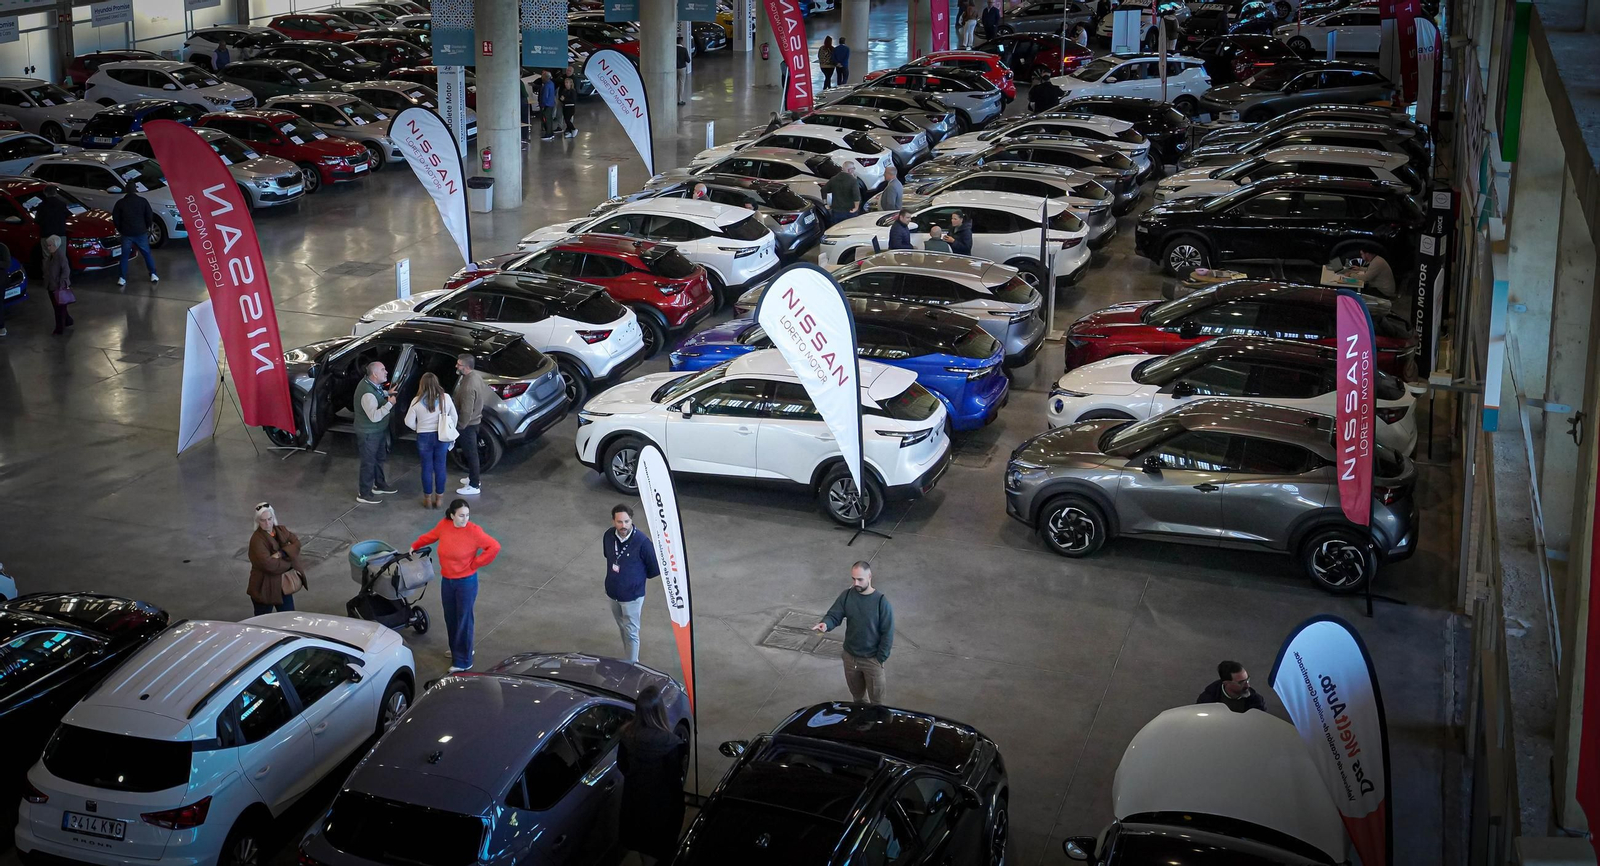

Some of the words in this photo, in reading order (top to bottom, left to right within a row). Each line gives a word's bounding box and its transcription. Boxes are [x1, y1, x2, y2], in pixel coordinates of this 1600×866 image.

[596, 72, 617, 97] LORETO
[614, 96, 631, 116] MOTOR
[597, 58, 644, 120] NISSAN
[404, 136, 427, 166] LORETO
[424, 165, 442, 191] MOTOR
[406, 119, 458, 196] NISSAN
[1417, 263, 1428, 308] MOTOR
[780, 315, 808, 355] LORETO
[805, 351, 828, 386] MOTOR
[782, 286, 849, 387] NISSAN
[1361, 349, 1370, 401] MOTOR
[1341, 333, 1360, 482] NISSAN
[1359, 403, 1370, 458] LORETO
[70, 815, 97, 831] 3414
